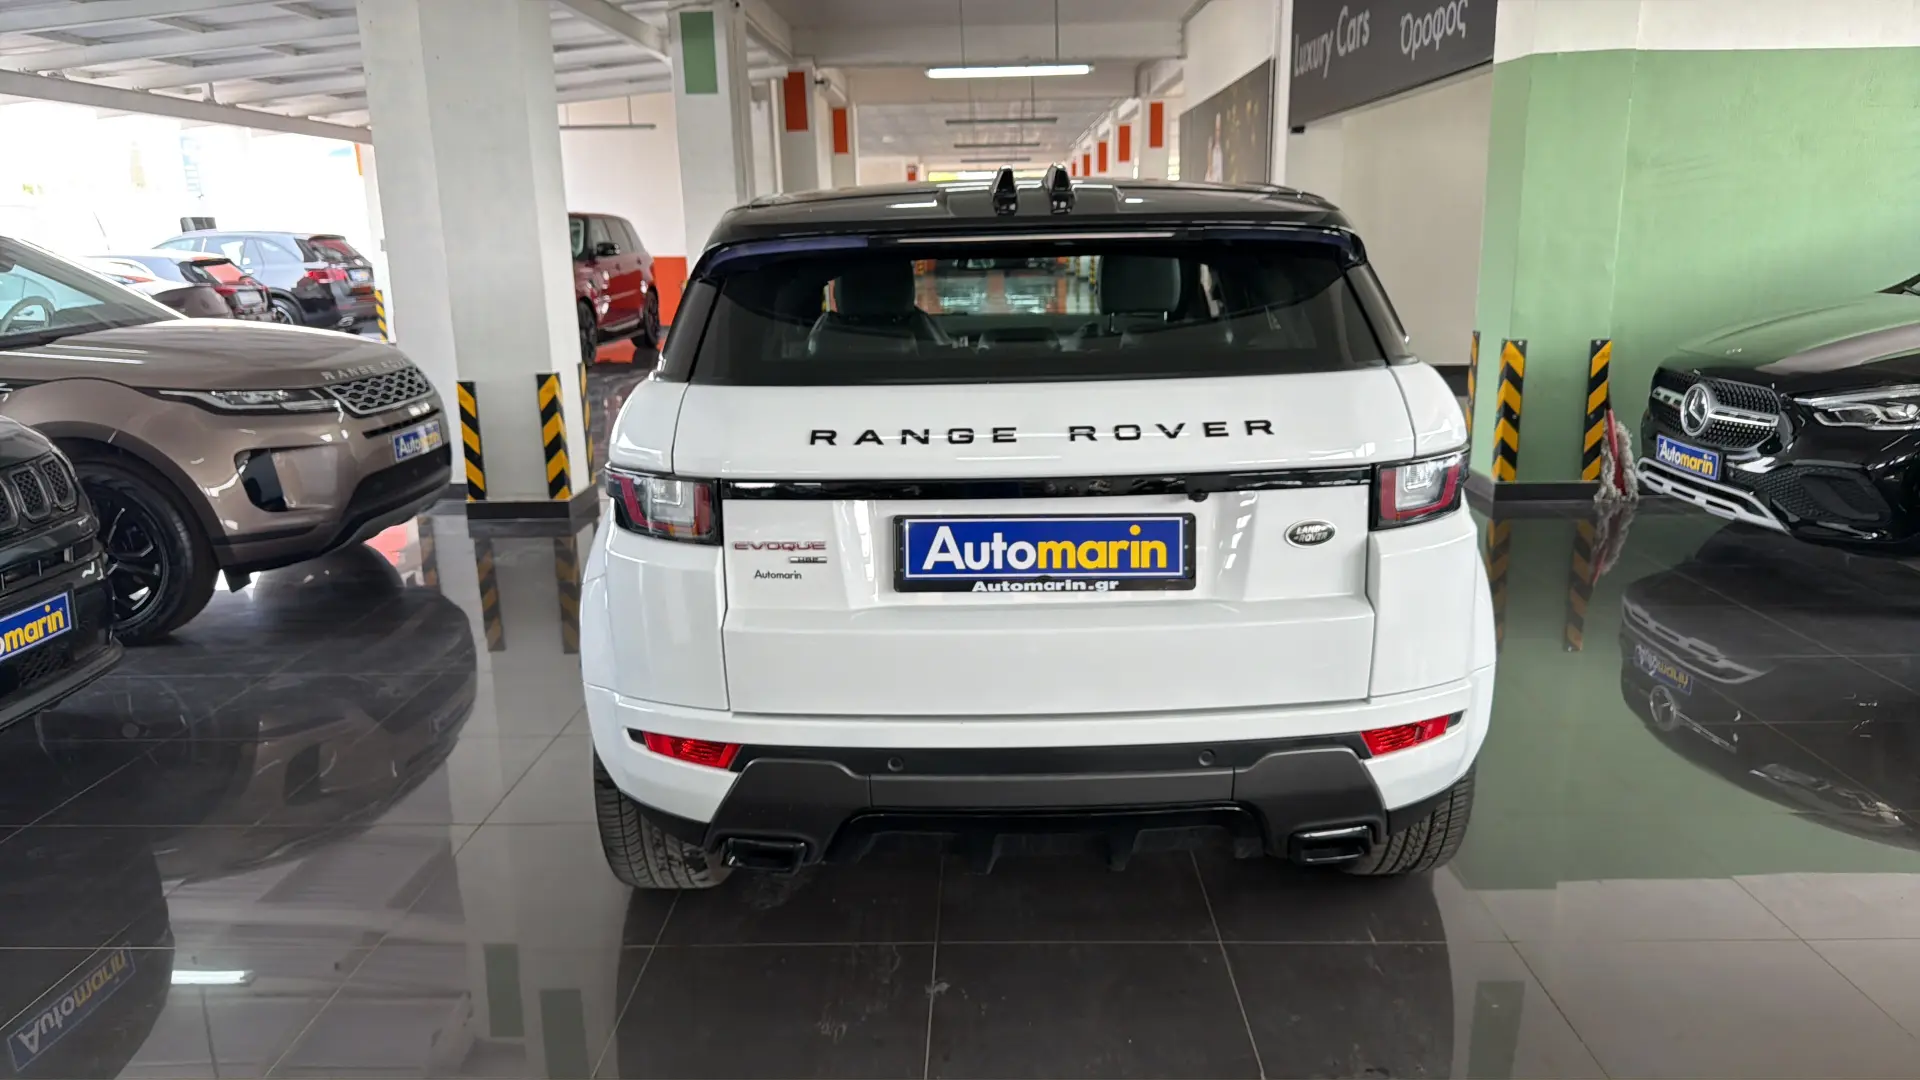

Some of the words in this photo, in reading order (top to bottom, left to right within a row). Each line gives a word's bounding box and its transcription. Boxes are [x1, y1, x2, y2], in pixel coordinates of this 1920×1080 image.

[1294, 30, 1334, 79] Luxury
[1336, 5, 1370, 57] Cars
[1400, 0, 1469, 61] Όροφος
[809, 426, 1018, 446] RANGE
[1068, 420, 1276, 443] ROVER
[1660, 439, 1714, 475] Automarin
[1296, 525, 1323, 535] LAND
[1298, 532, 1328, 543] ROVER
[733, 541, 827, 551] EVOQUE
[921, 524, 1168, 570] Automarin
[754, 570, 802, 579] Automarin
[971, 579, 1120, 592] Automarin.gr
[0, 604, 65, 655] marin
